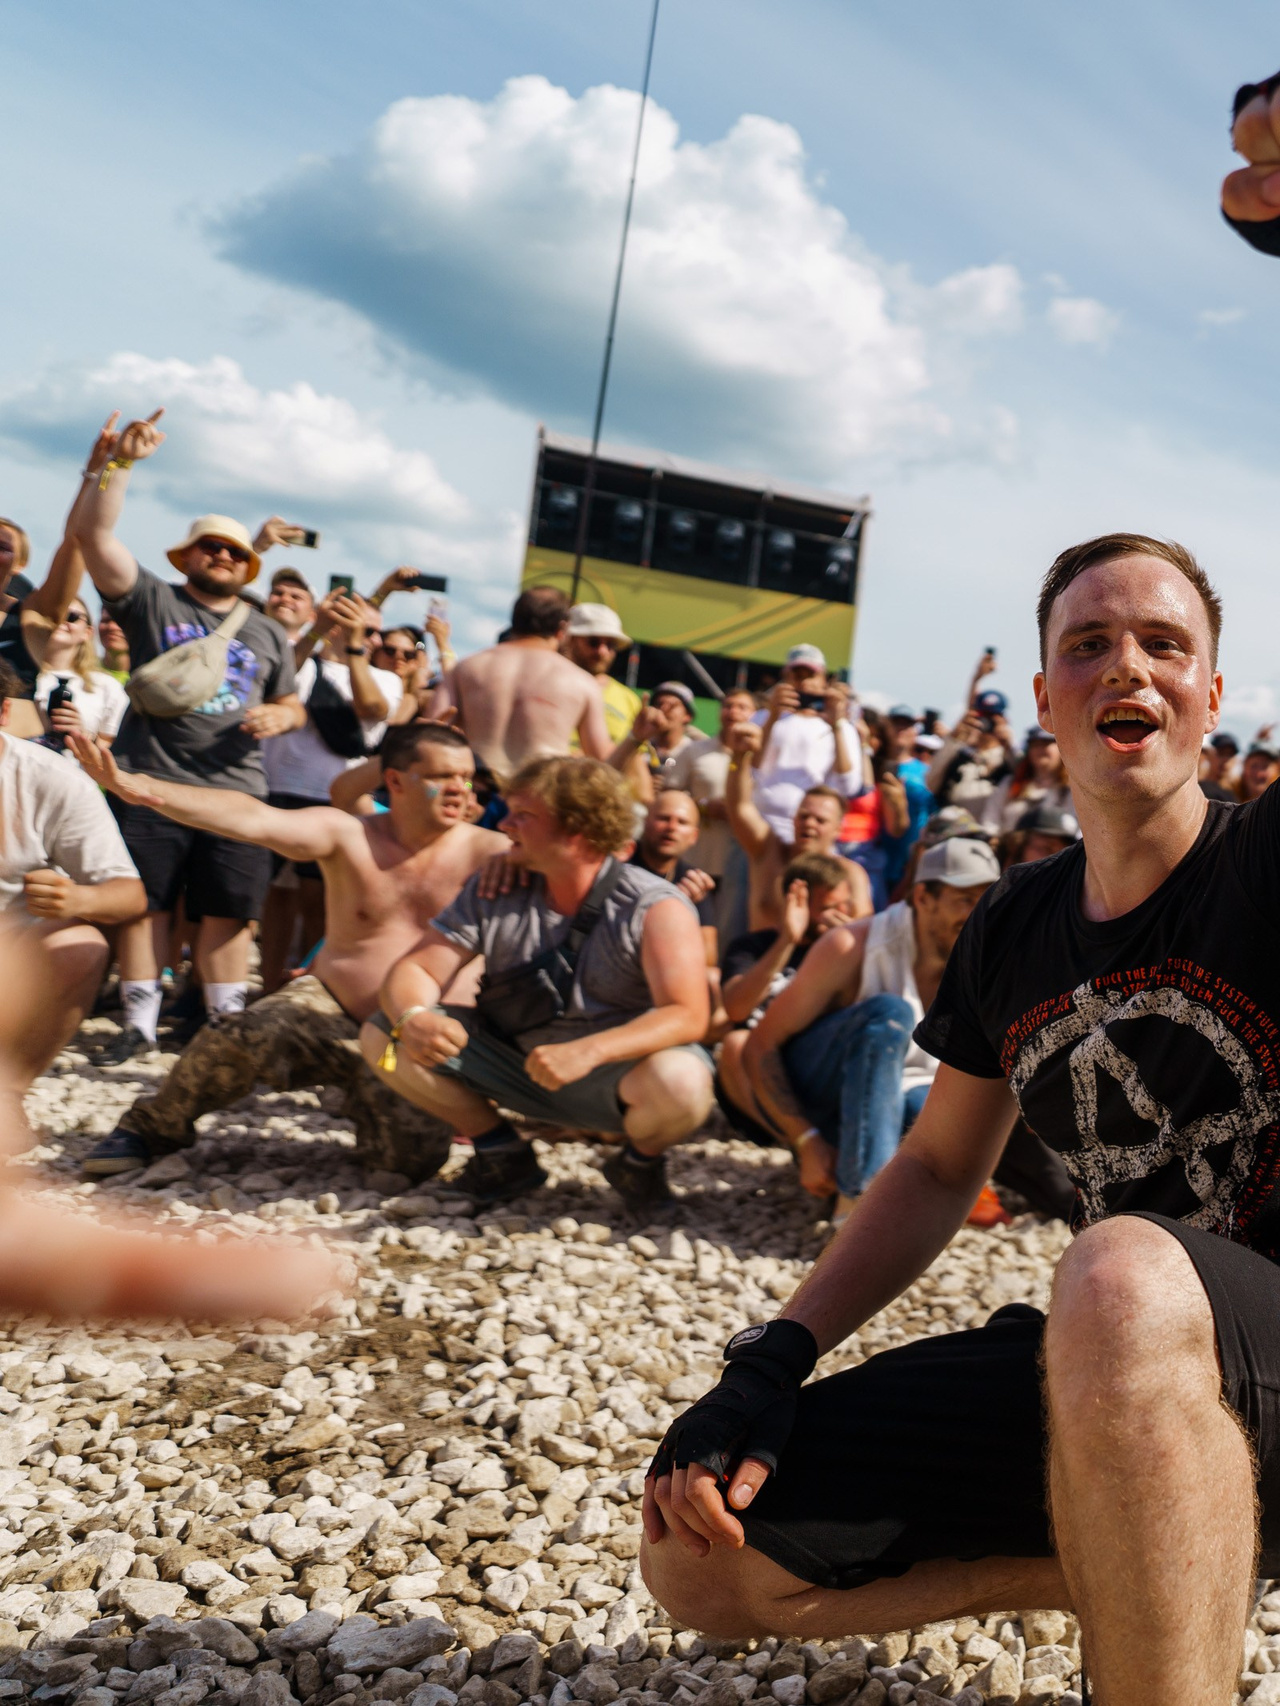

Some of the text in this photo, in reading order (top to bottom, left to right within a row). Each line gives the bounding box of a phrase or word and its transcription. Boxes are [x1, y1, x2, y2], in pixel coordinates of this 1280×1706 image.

[1095, 971, 1122, 990] FUCK
[1125, 967, 1147, 981] THE
[1167, 957, 1194, 974] FUCK
[1193, 965, 1213, 984] THE
[1214, 977, 1256, 1014] SYSTEM
[1255, 1010, 1279, 1040] FUCK
[1018, 1011, 1049, 1041] SYSTEM
[1156, 974, 1177, 986] THE
[1214, 999, 1242, 1027] FUCK
[1241, 1022, 1261, 1045] THE
[1255, 1043, 1279, 1089] SYSTEM
